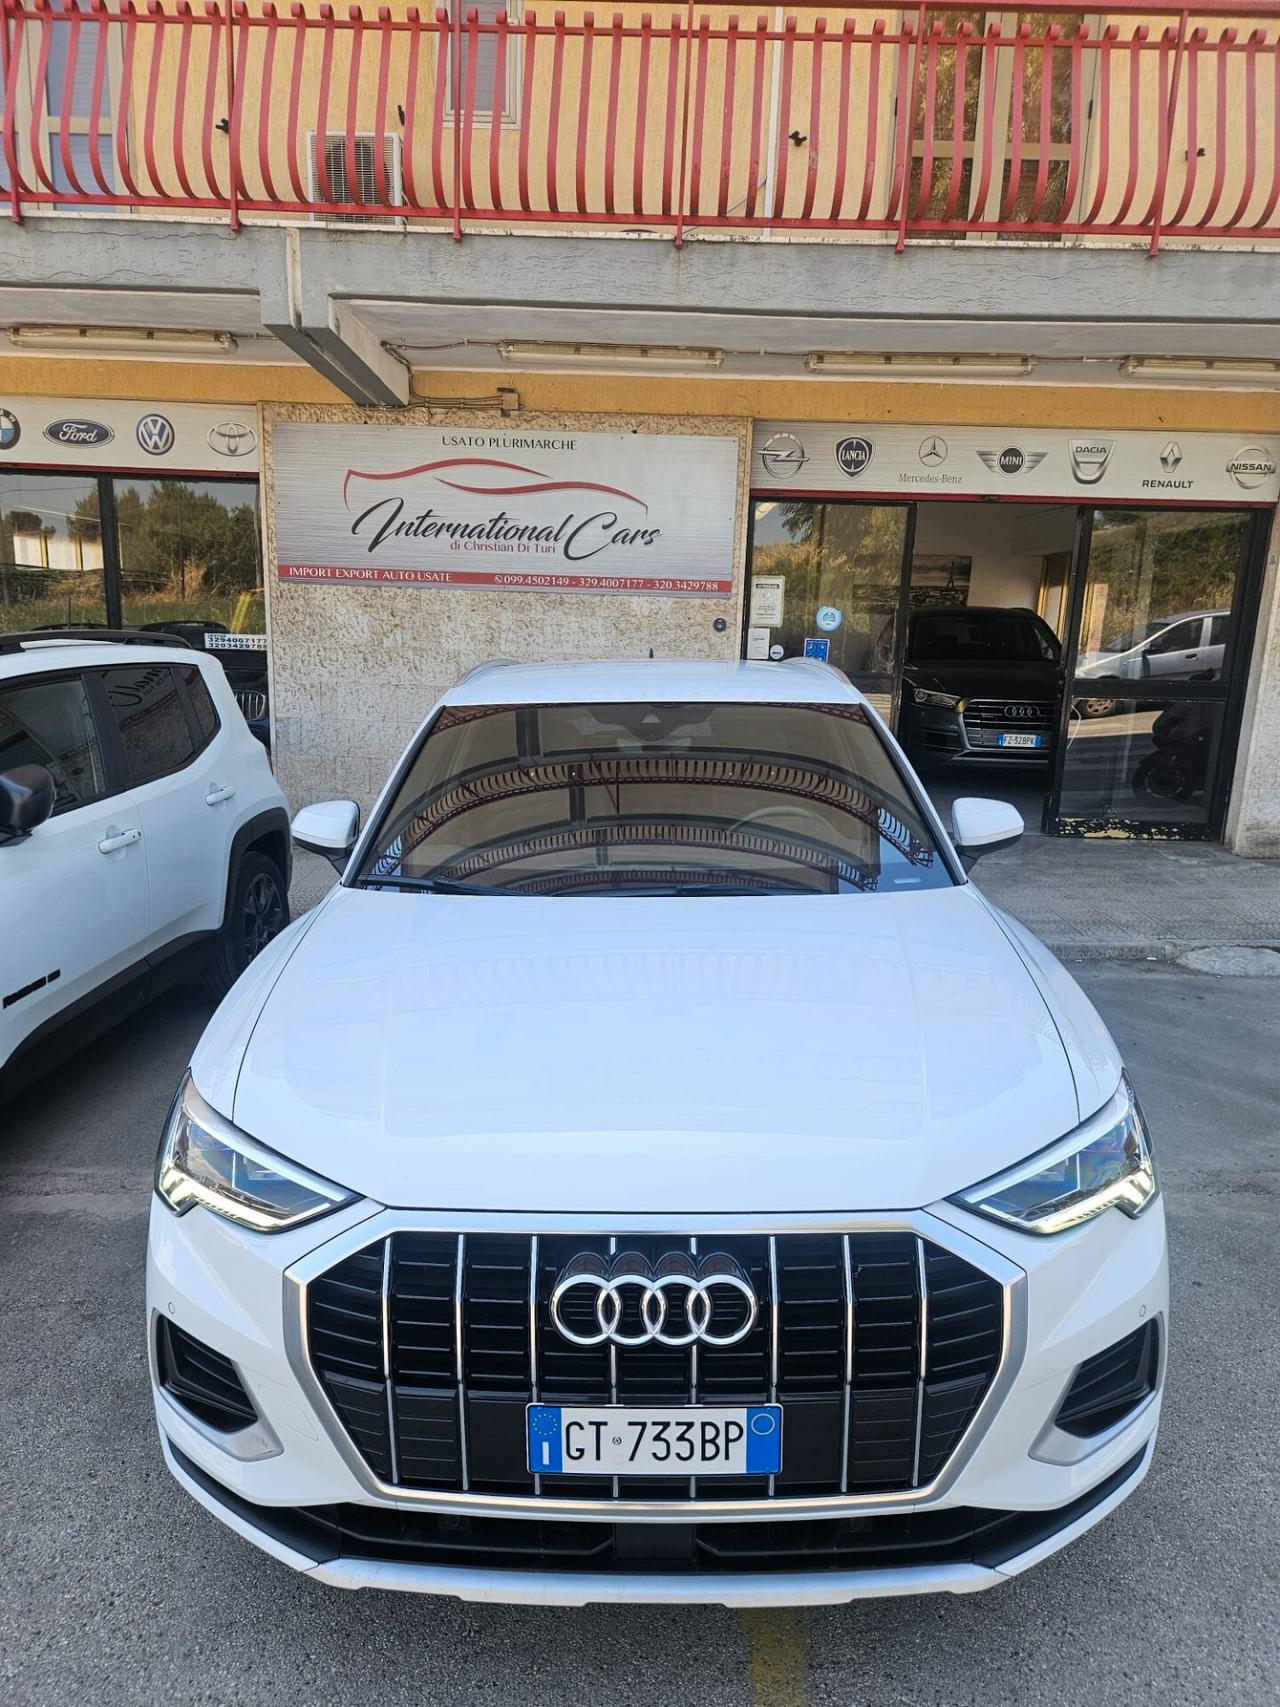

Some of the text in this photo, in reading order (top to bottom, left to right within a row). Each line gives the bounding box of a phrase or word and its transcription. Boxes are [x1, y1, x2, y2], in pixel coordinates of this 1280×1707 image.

[59, 422, 98, 443] Ford
[442, 435, 578, 450] USATO PLURIMARCHE
[1075, 445, 1107, 454] DACIA
[841, 449, 866, 462] LANCIA
[1000, 456, 1022, 465] MINI
[1230, 462, 1272, 471] NISSAN
[898, 473, 963, 485] Mercedes-Benz
[1142, 479, 1194, 489] RENAULT
[351, 497, 662, 561] International Cars
[450, 540, 556, 554] di Christian Di Turi
[289, 567, 452, 582] IMPORT EXPORT AUTO USATE
[504, 575, 569, 586] 099.4502149
[579, 578, 644, 589] 329.4007177
[653, 580, 718, 591] 320.3429788
[565, 1420, 744, 1462] GT 733BP
